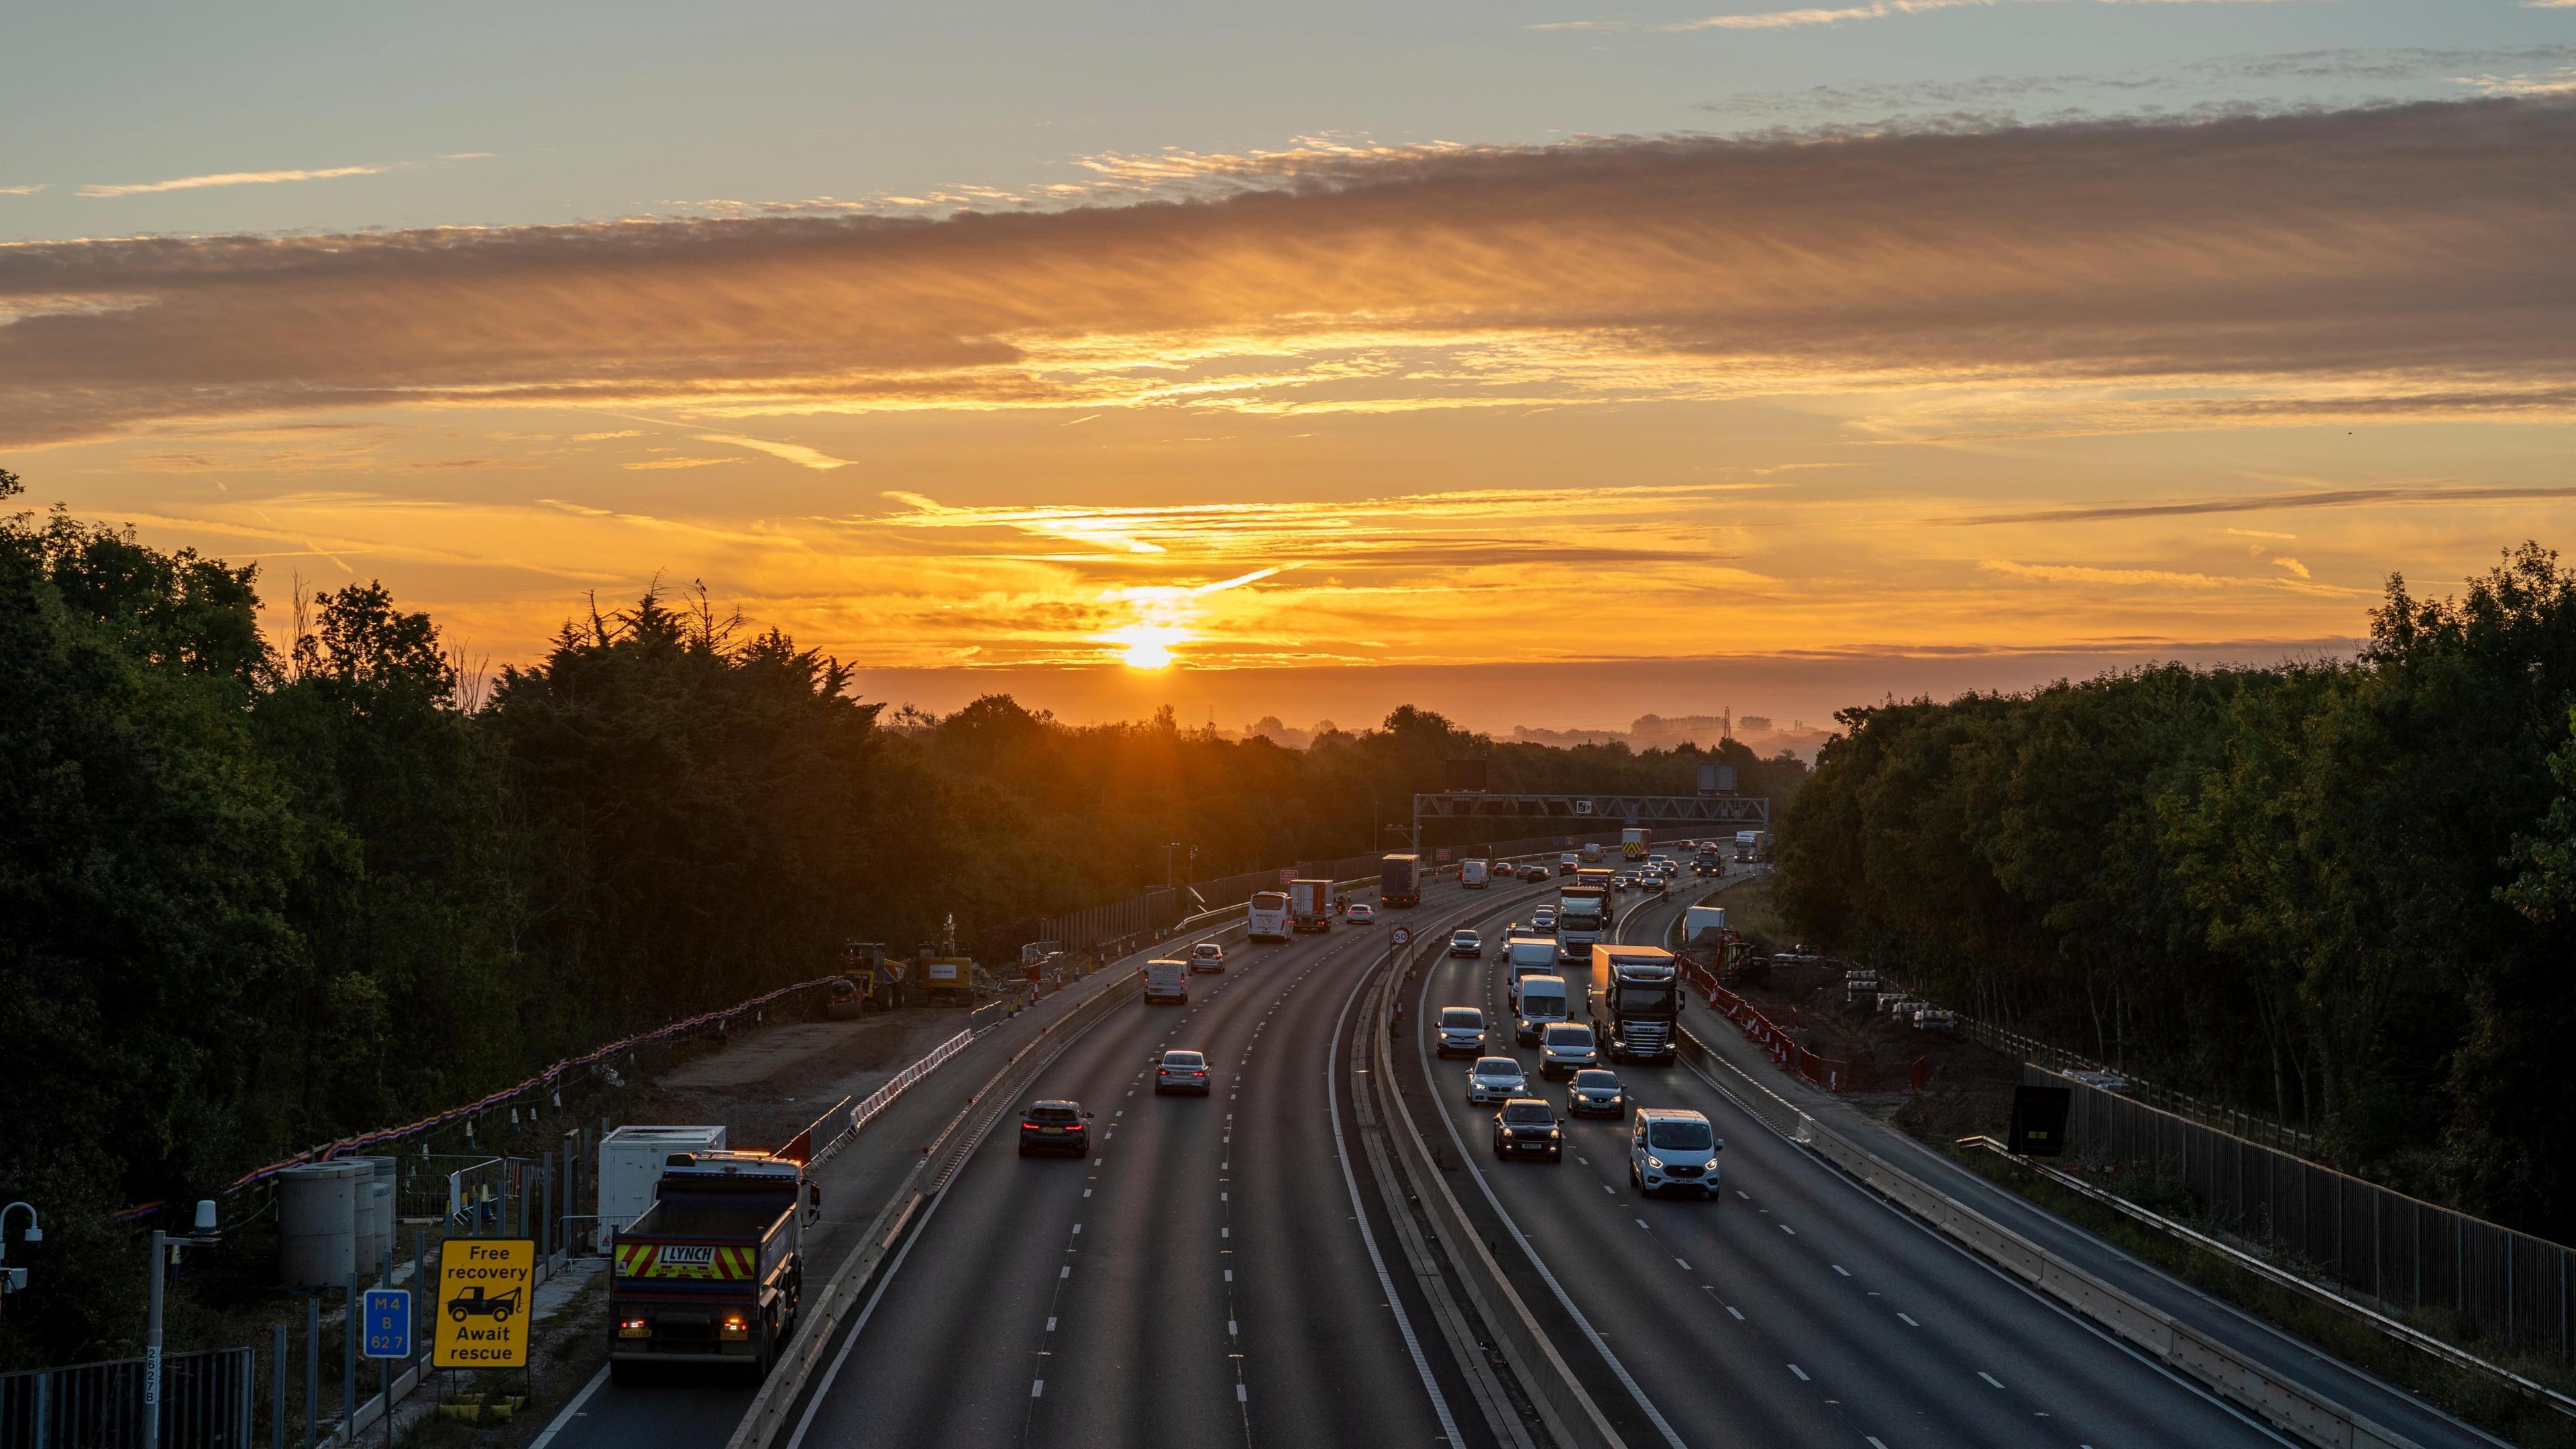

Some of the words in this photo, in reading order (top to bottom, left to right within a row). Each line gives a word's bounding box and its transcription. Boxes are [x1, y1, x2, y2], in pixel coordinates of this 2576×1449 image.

[470, 1246, 509, 1260] Free
[671, 1247, 712, 1261] LYNCH
[447, 1267, 528, 1281] recovery
[382, 1317, 392, 1330] B
[455, 1326, 510, 1341] Await
[371, 1336, 404, 1349] 62.7
[450, 1348, 513, 1360] rescue
